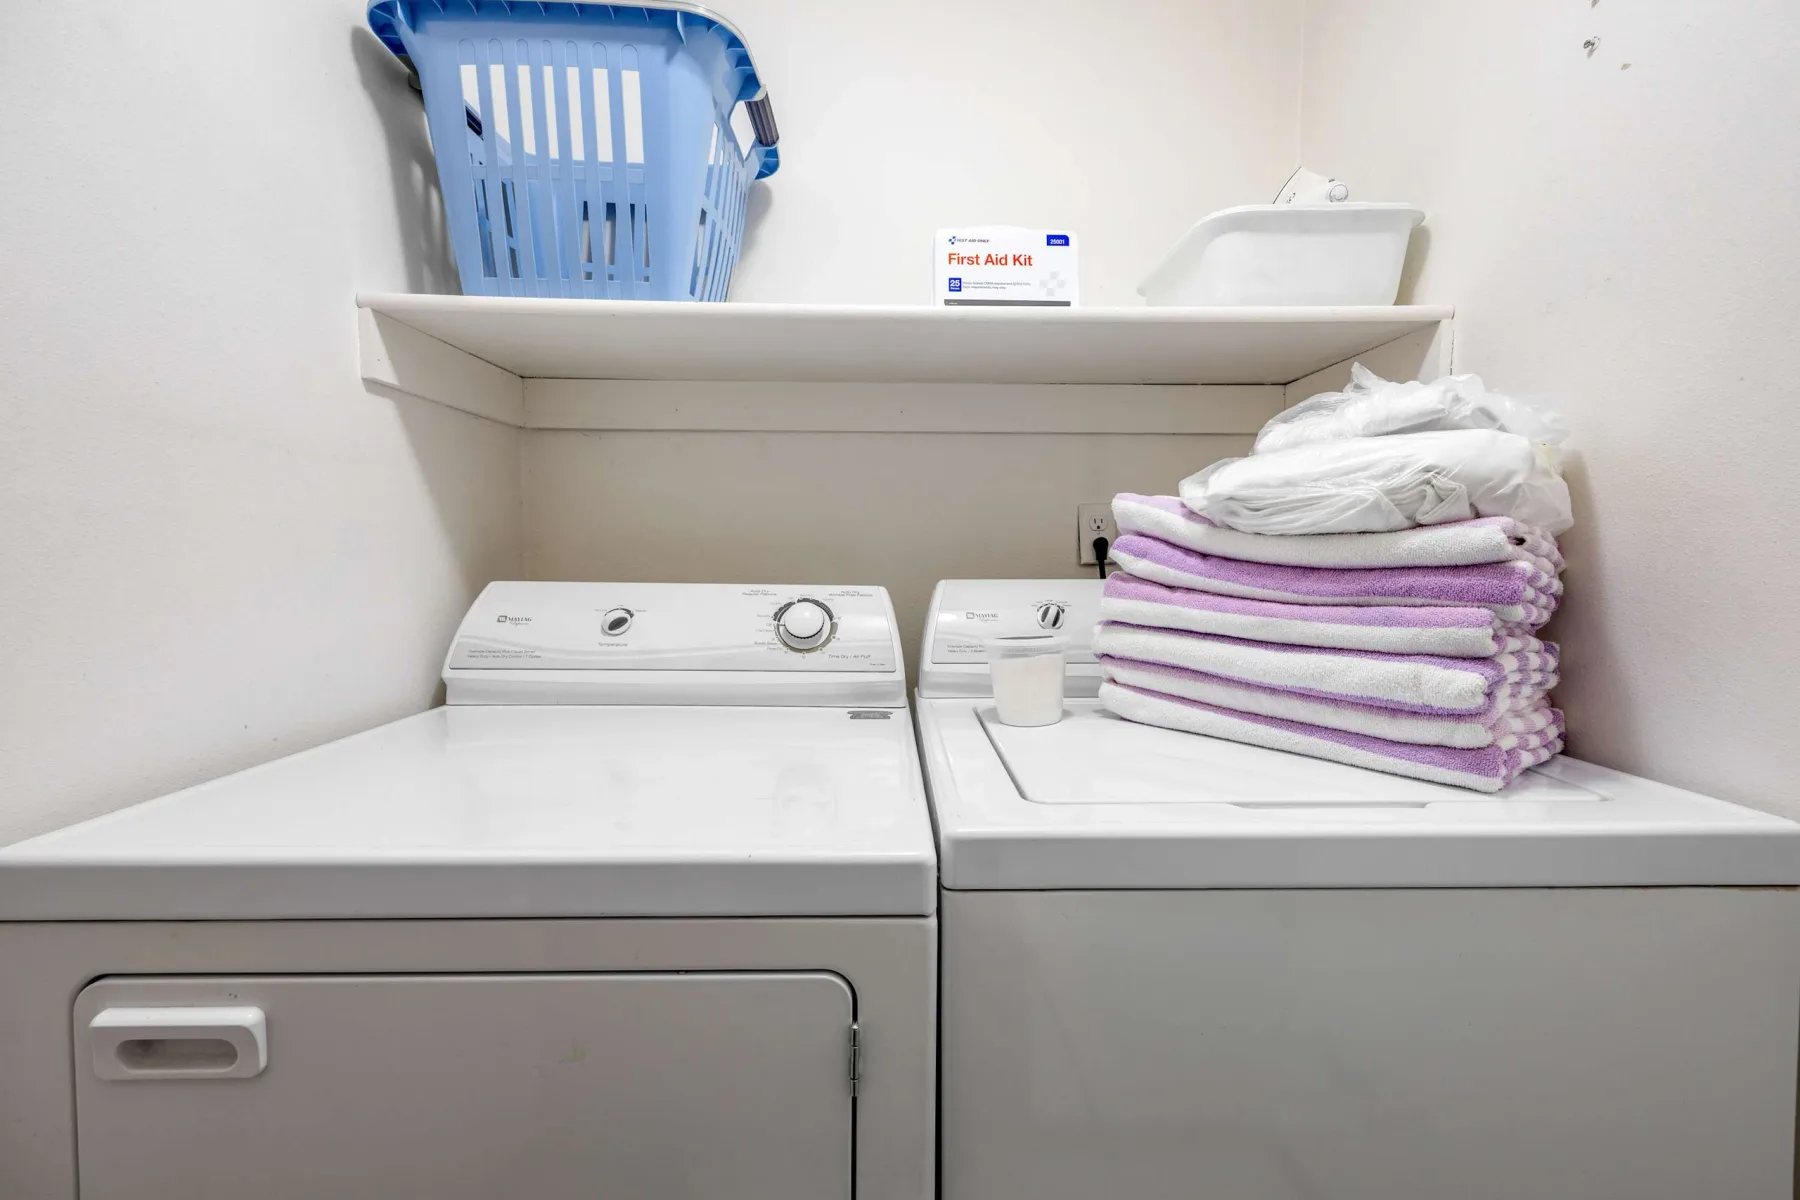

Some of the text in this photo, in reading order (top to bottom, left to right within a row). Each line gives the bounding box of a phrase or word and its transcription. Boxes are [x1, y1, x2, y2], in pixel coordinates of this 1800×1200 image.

[948, 253, 1033, 266] First Aid Kit
